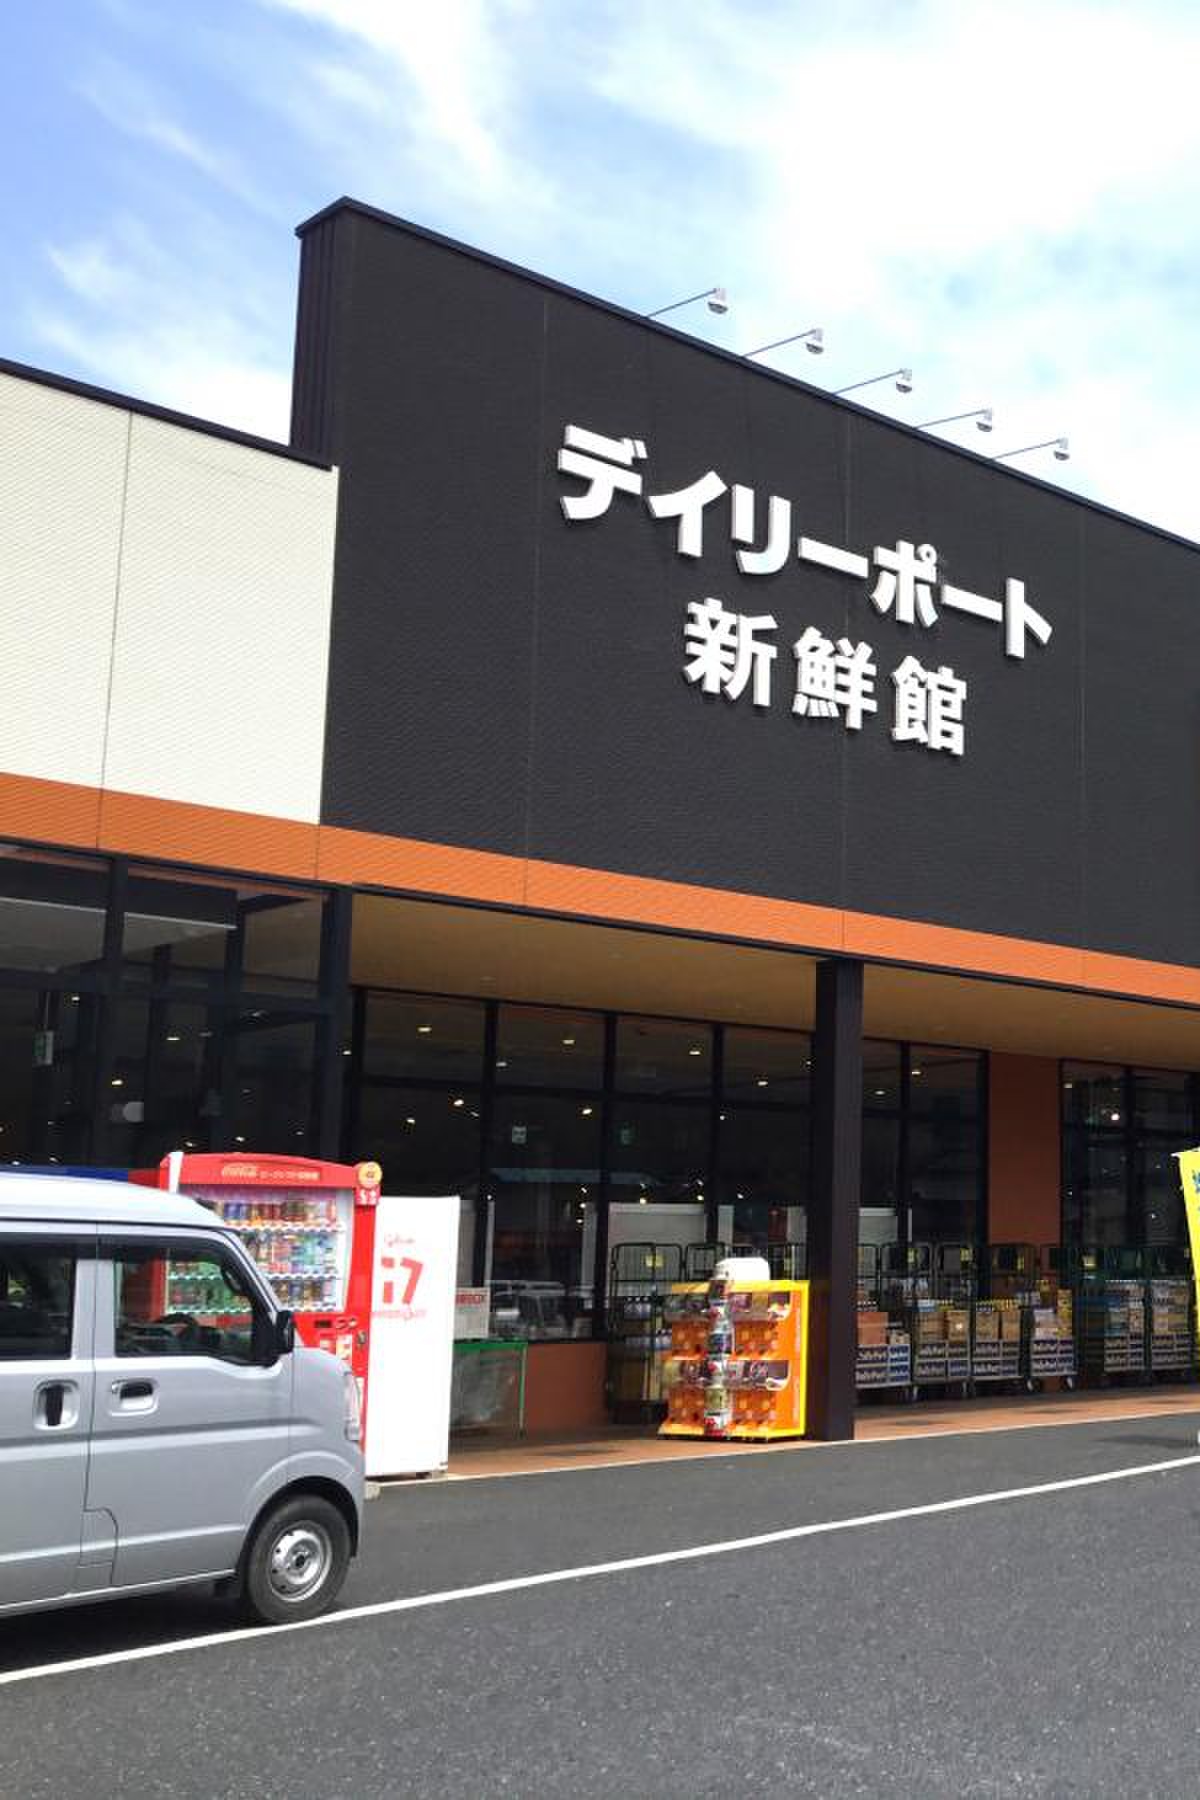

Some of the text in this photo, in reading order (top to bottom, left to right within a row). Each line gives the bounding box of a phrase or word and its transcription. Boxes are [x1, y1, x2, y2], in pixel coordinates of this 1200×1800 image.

[557, 424, 1052, 659] デイリーポート
[684, 597, 967, 756] 新鮮館
